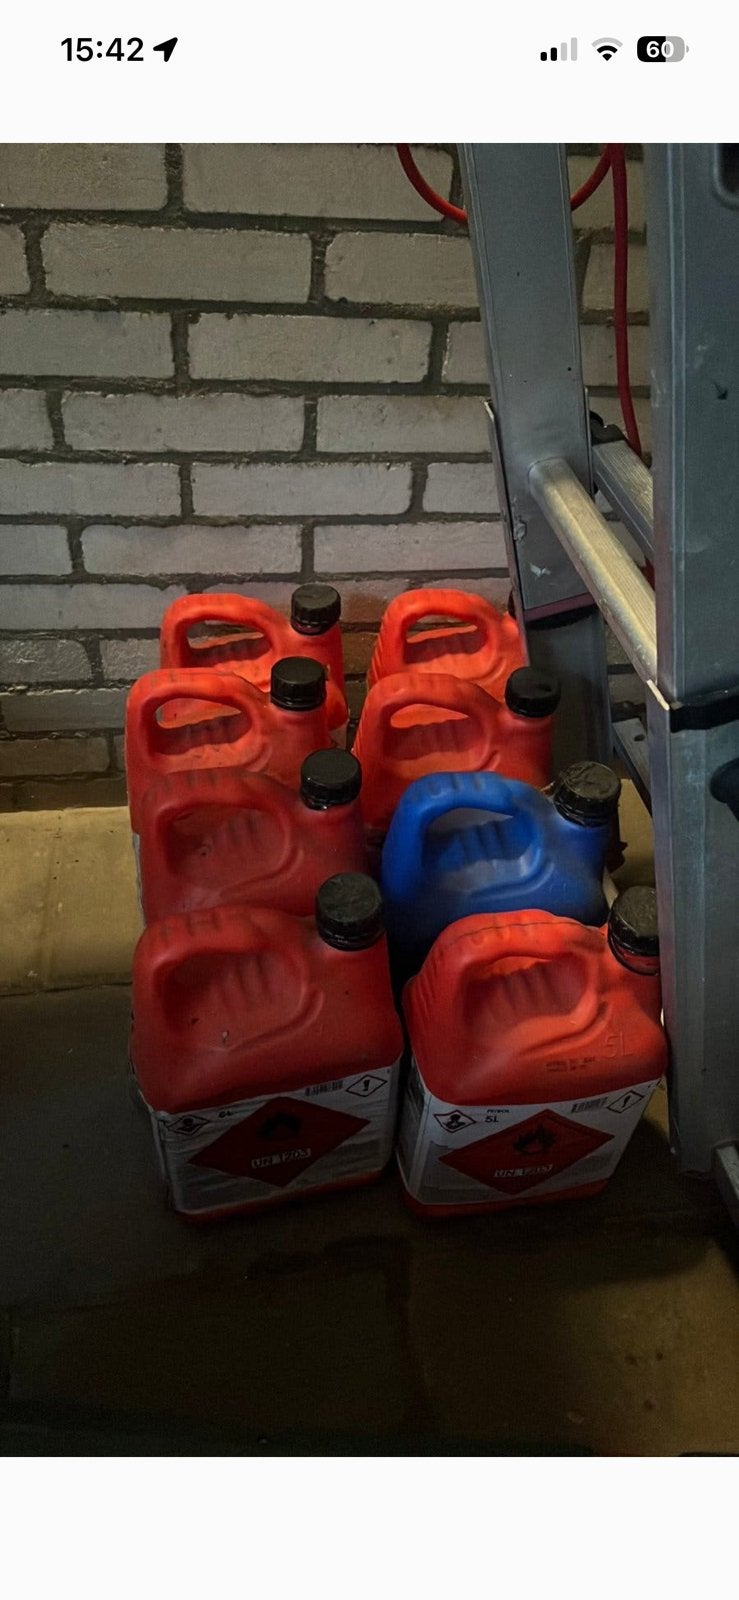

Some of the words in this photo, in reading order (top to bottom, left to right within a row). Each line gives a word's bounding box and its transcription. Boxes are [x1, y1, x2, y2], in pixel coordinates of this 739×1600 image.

[605, 1032, 633, 1058] 5L
[485, 1115, 499, 1123] 5L
[254, 1156, 272, 1168] UN
[280, 1148, 307, 1161] 1203
[496, 1169, 515, 1178] UN
